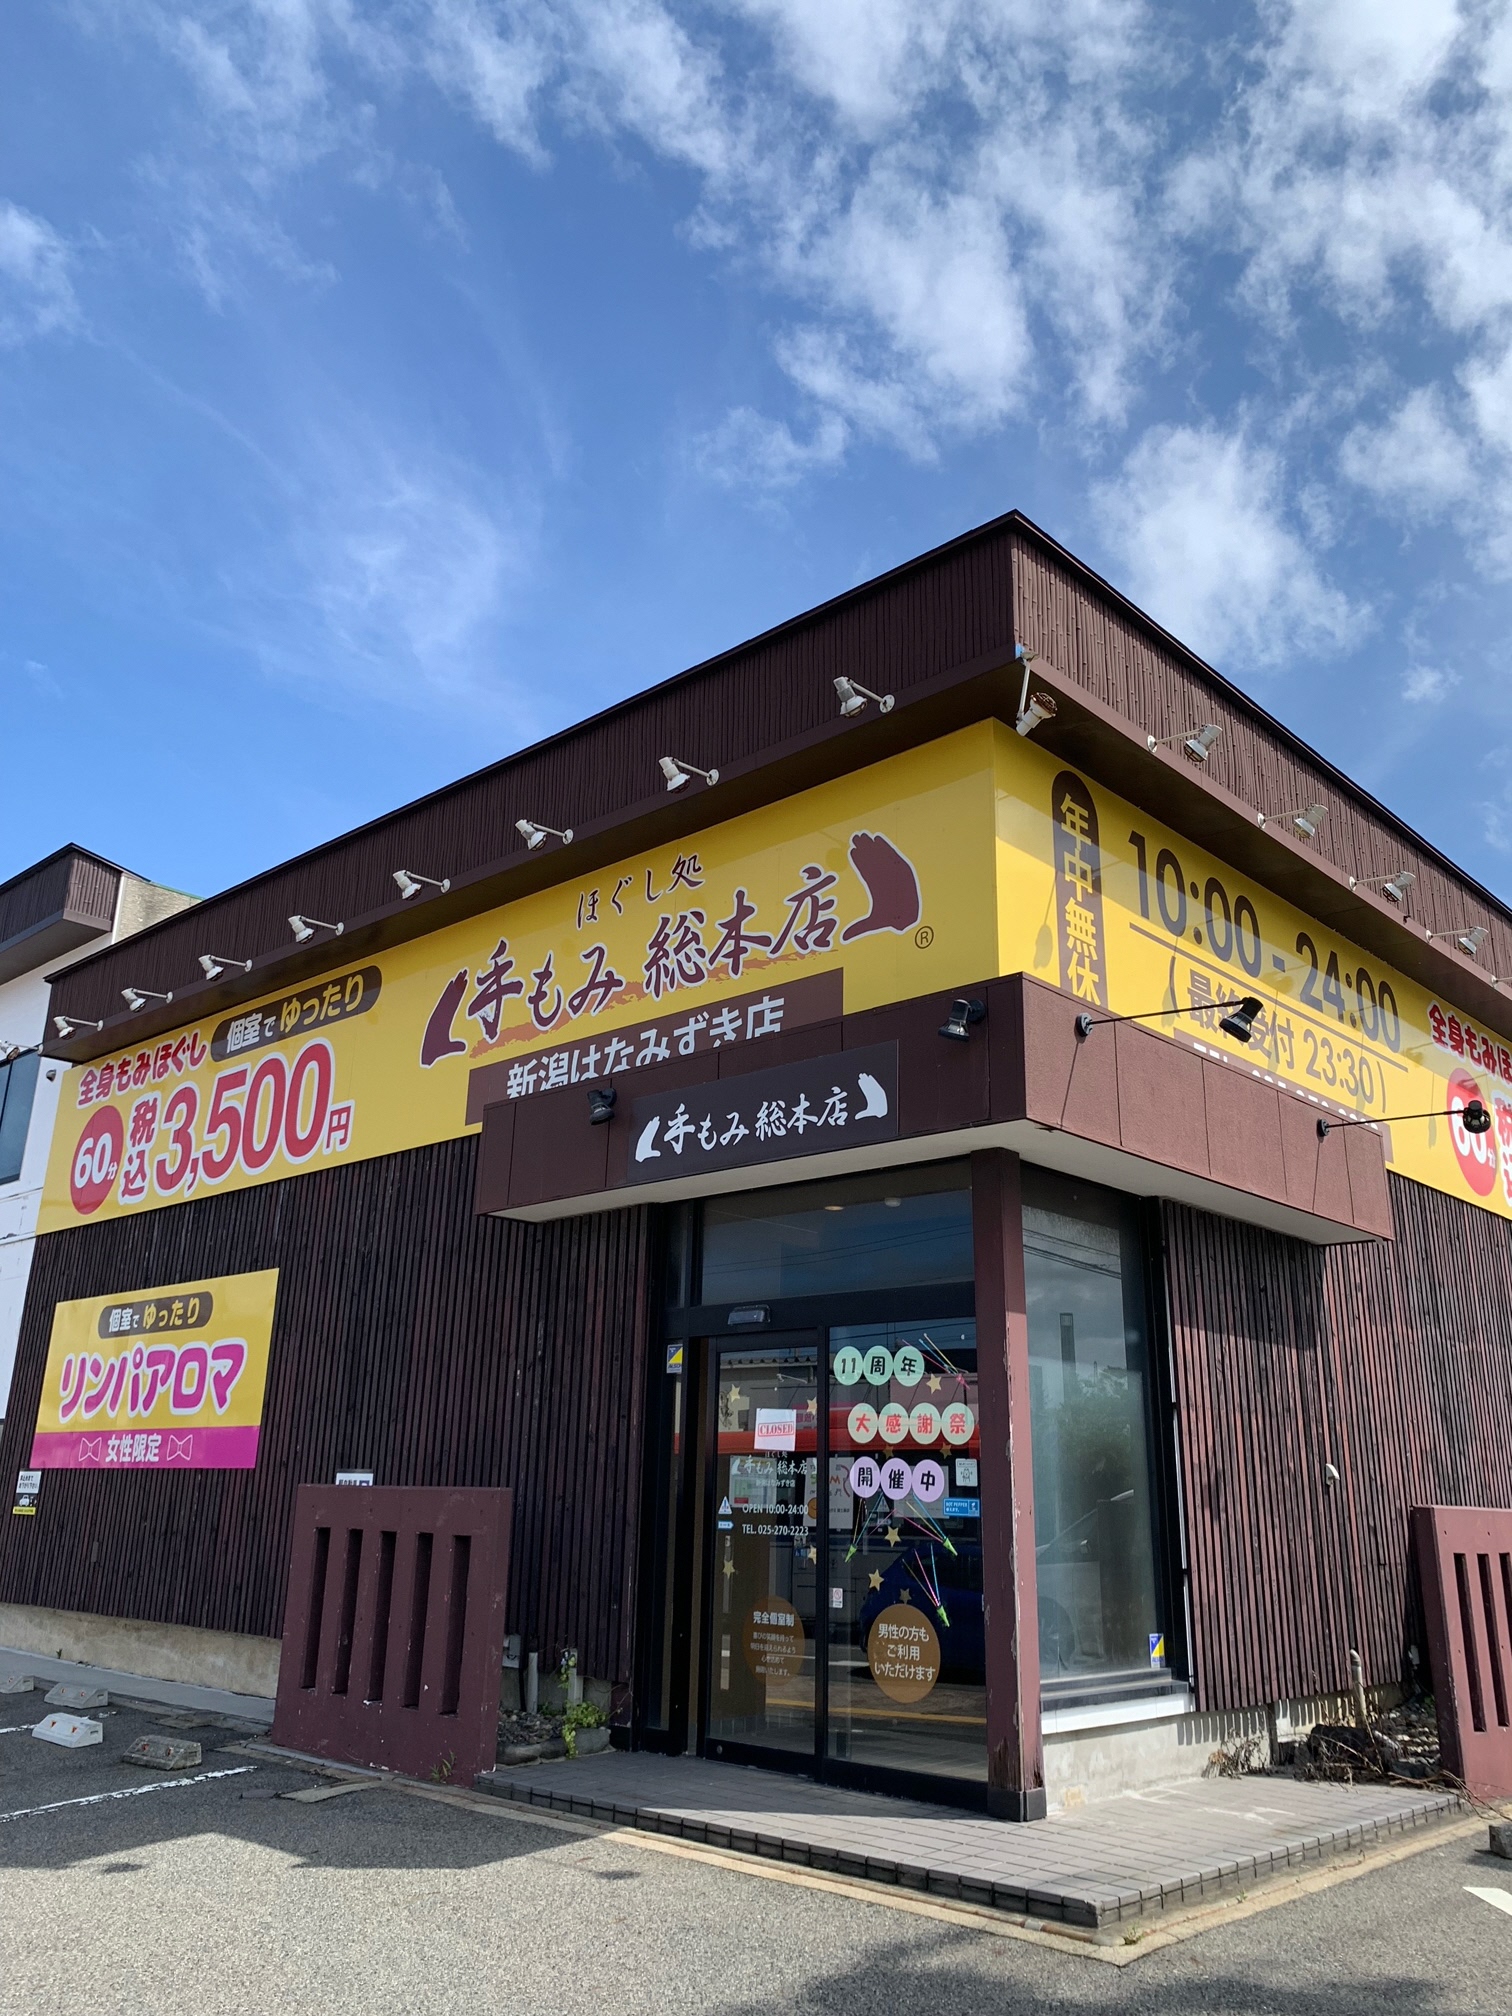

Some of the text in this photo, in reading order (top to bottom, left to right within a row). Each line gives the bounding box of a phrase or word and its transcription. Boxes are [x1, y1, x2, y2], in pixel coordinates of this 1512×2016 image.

[576, 852, 704, 930] ほぐし処
[1060, 794, 1101, 1006] 年中無休
[466, 863, 840, 1046] 手もみ総本店
[1128, 830, 1262, 978] 10:00
[1296, 931, 1400, 1054] 24:00
[227, 974, 365, 1054] 個室でゆったり
[507, 995, 785, 1100] 新潟はなみずき店
[78, 1031, 207, 1106] 全身もみほぐし
[664, 1086, 849, 1154] 手もみ総本店
[109, 1297, 200, 1333] 個室でゆったり
[60, 1342, 246, 1420] リンパアロマ
[760, 1423, 793, 1434] CLOSED
[855, 1413, 966, 1435] 大感謝祭
[105, 1434, 162, 1463] 女性限定
[744, 1455, 808, 1475] 手もみ総本店
[858, 1467, 936, 1491] 開催中
[742, 1504, 762, 1514] OPEN
[765, 1504, 809, 1515] 10:00-24:00
[742, 1524, 756, 1534] TEL.
[758, 1525, 809, 1536] 025-270-2223
[753, 1611, 795, 1627] 完全個室制
[878, 1623, 930, 1642] 男性の方も
[887, 1644, 920, 1661] ご利用
[874, 1661, 936, 1682] いただけます
